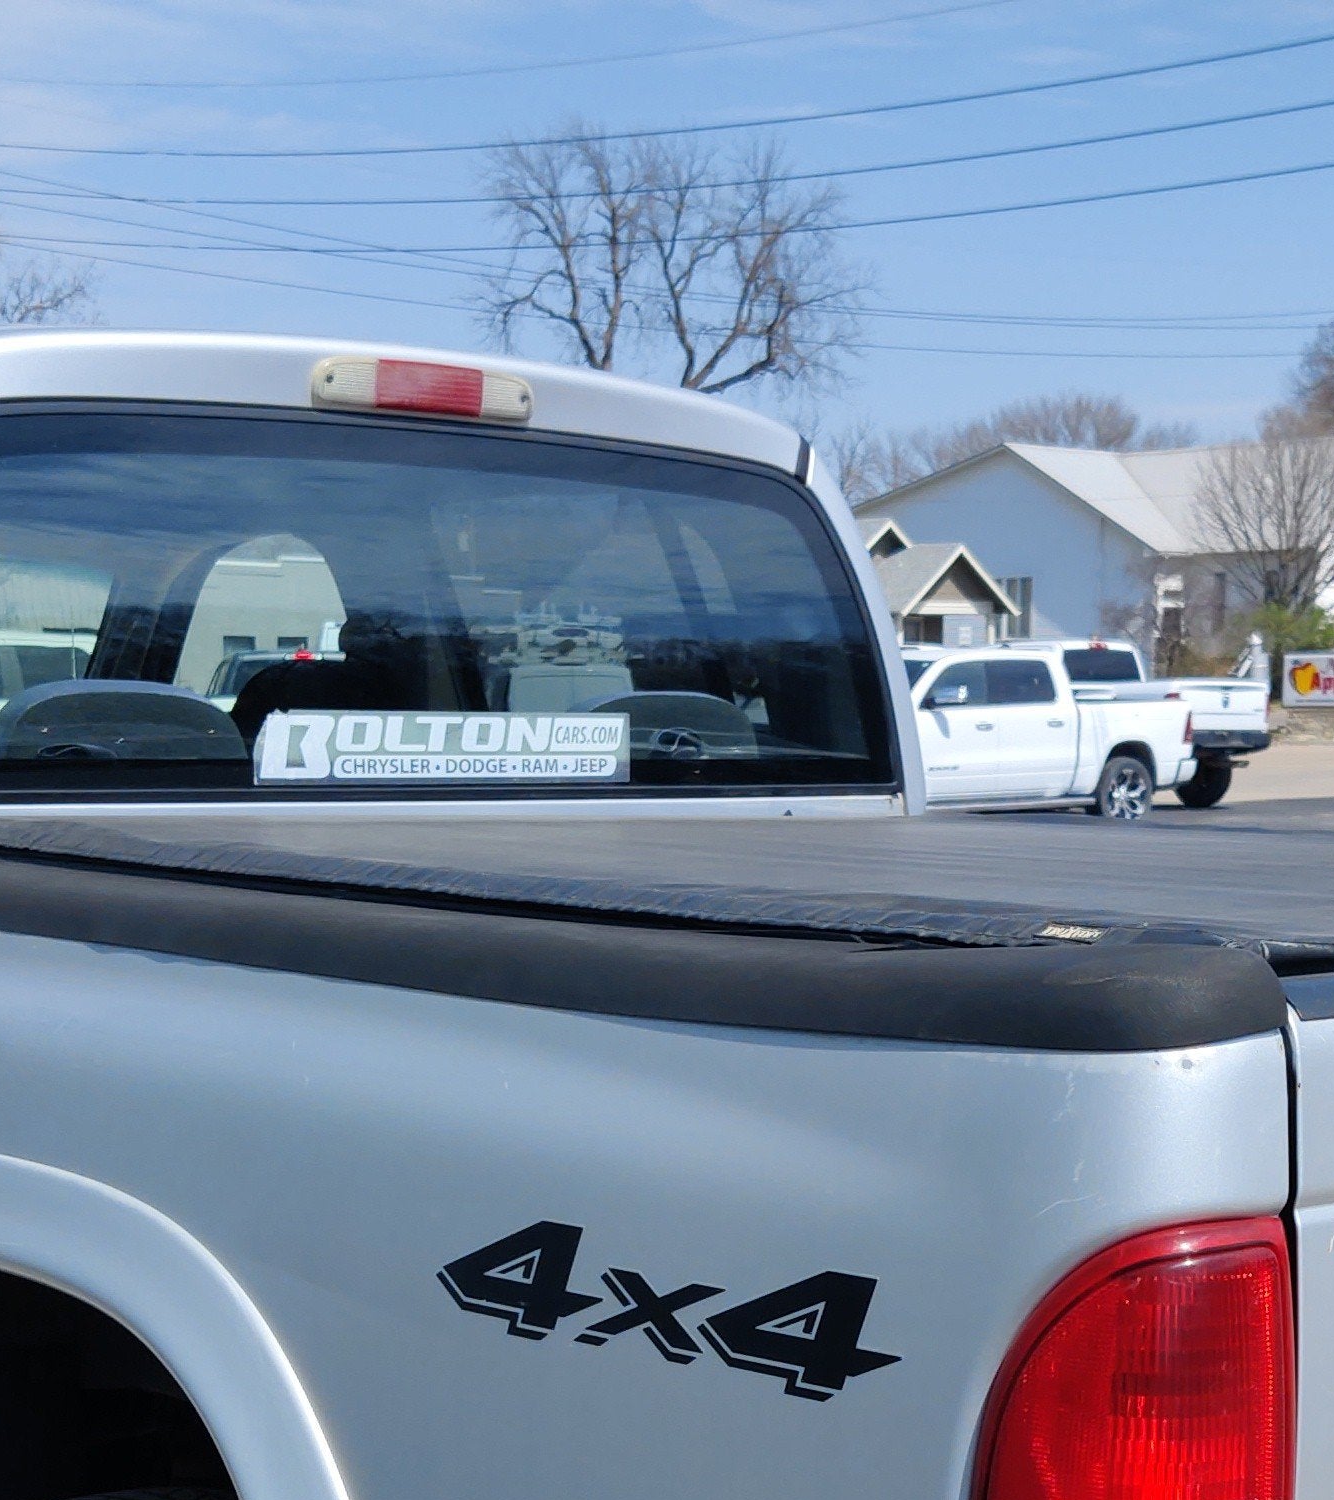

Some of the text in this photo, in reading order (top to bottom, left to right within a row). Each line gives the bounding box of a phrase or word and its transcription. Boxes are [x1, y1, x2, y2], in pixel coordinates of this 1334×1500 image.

[260, 714, 619, 779] BOLTON CARS.COM
[340, 757, 608, 774] CHRYSLER DODGE RAM JEEP
